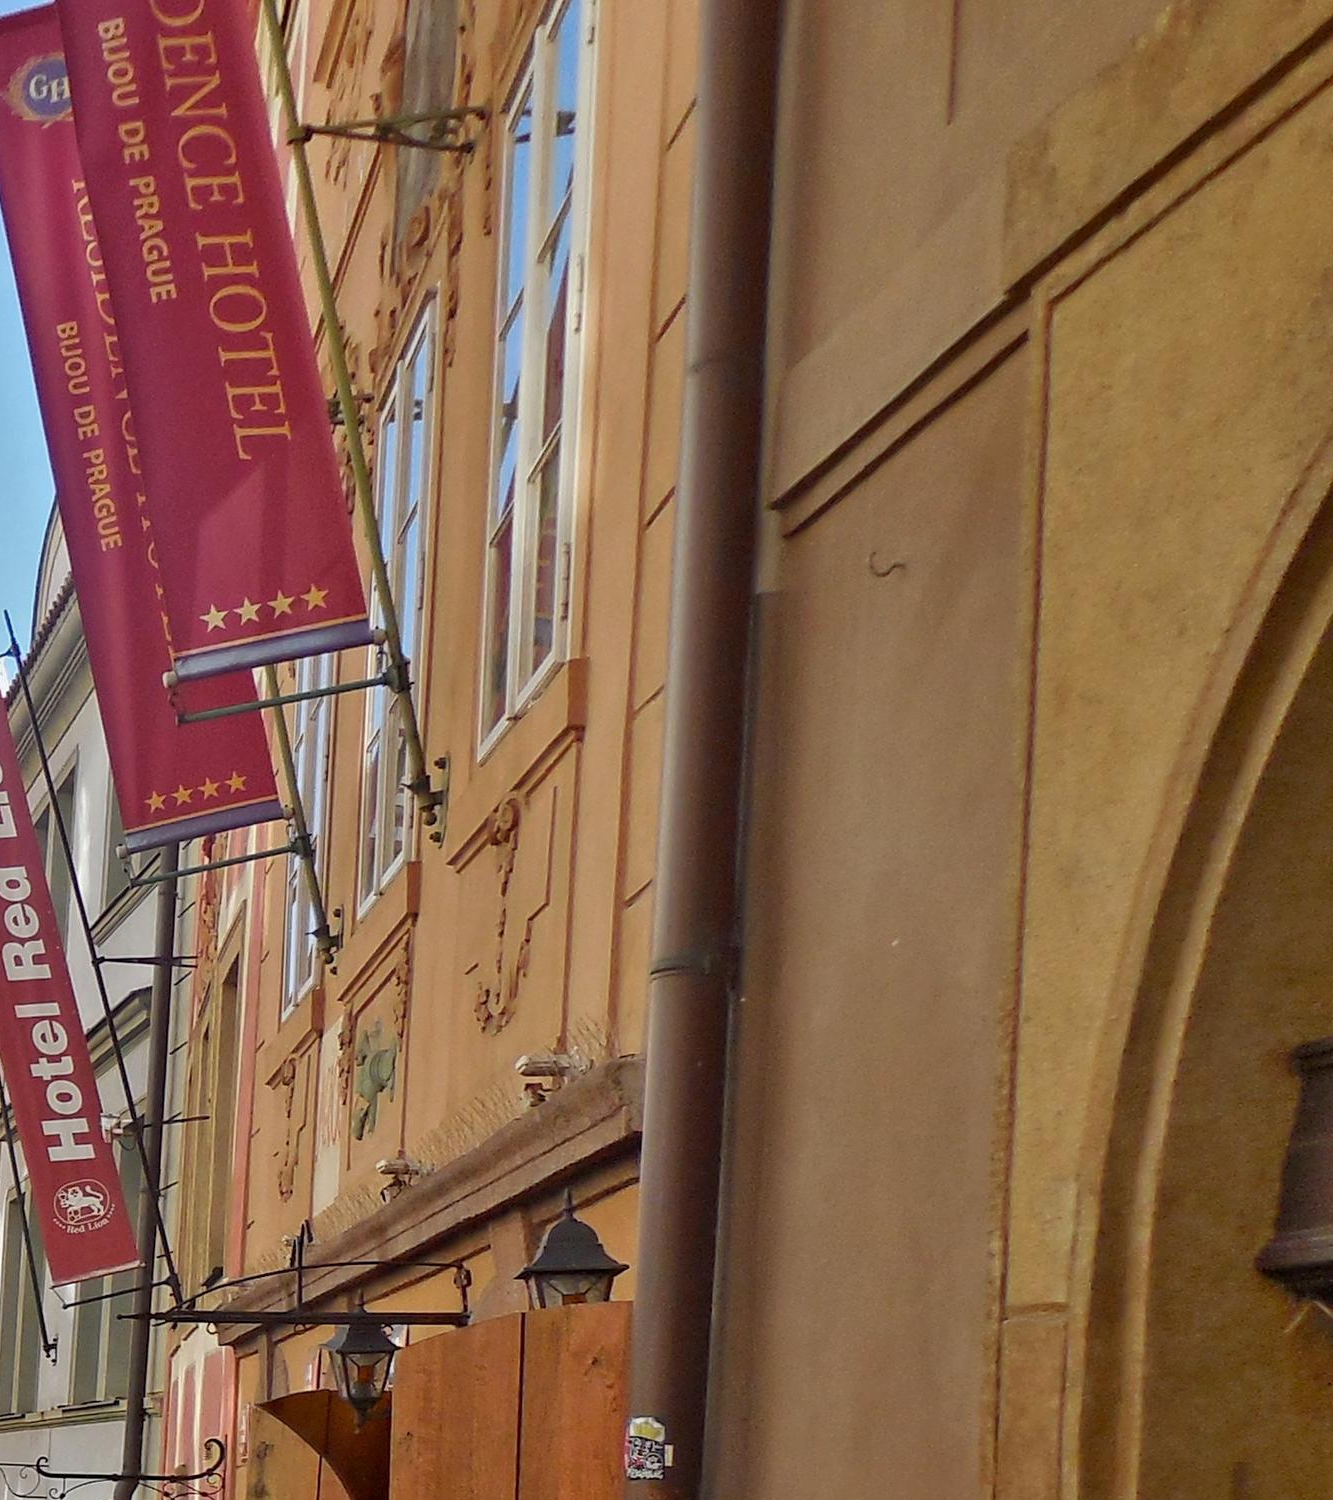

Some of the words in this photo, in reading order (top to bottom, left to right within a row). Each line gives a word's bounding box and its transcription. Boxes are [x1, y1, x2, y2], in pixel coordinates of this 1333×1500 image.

[97, 17, 140, 107] BIJOU
[118, 121, 150, 164] DE
[129, 175, 177, 304] PRAGUE
[56, 320, 90, 395] BIJOU
[196, 228, 291, 460] HOTEL
[73, 404, 100, 441] DE
[83, 448, 123, 552] PRAGUE
[14, 1003, 97, 1163] Hotel
[66, 1225, 86, 1234] Red
[87, 1218, 110, 1231] Lion
